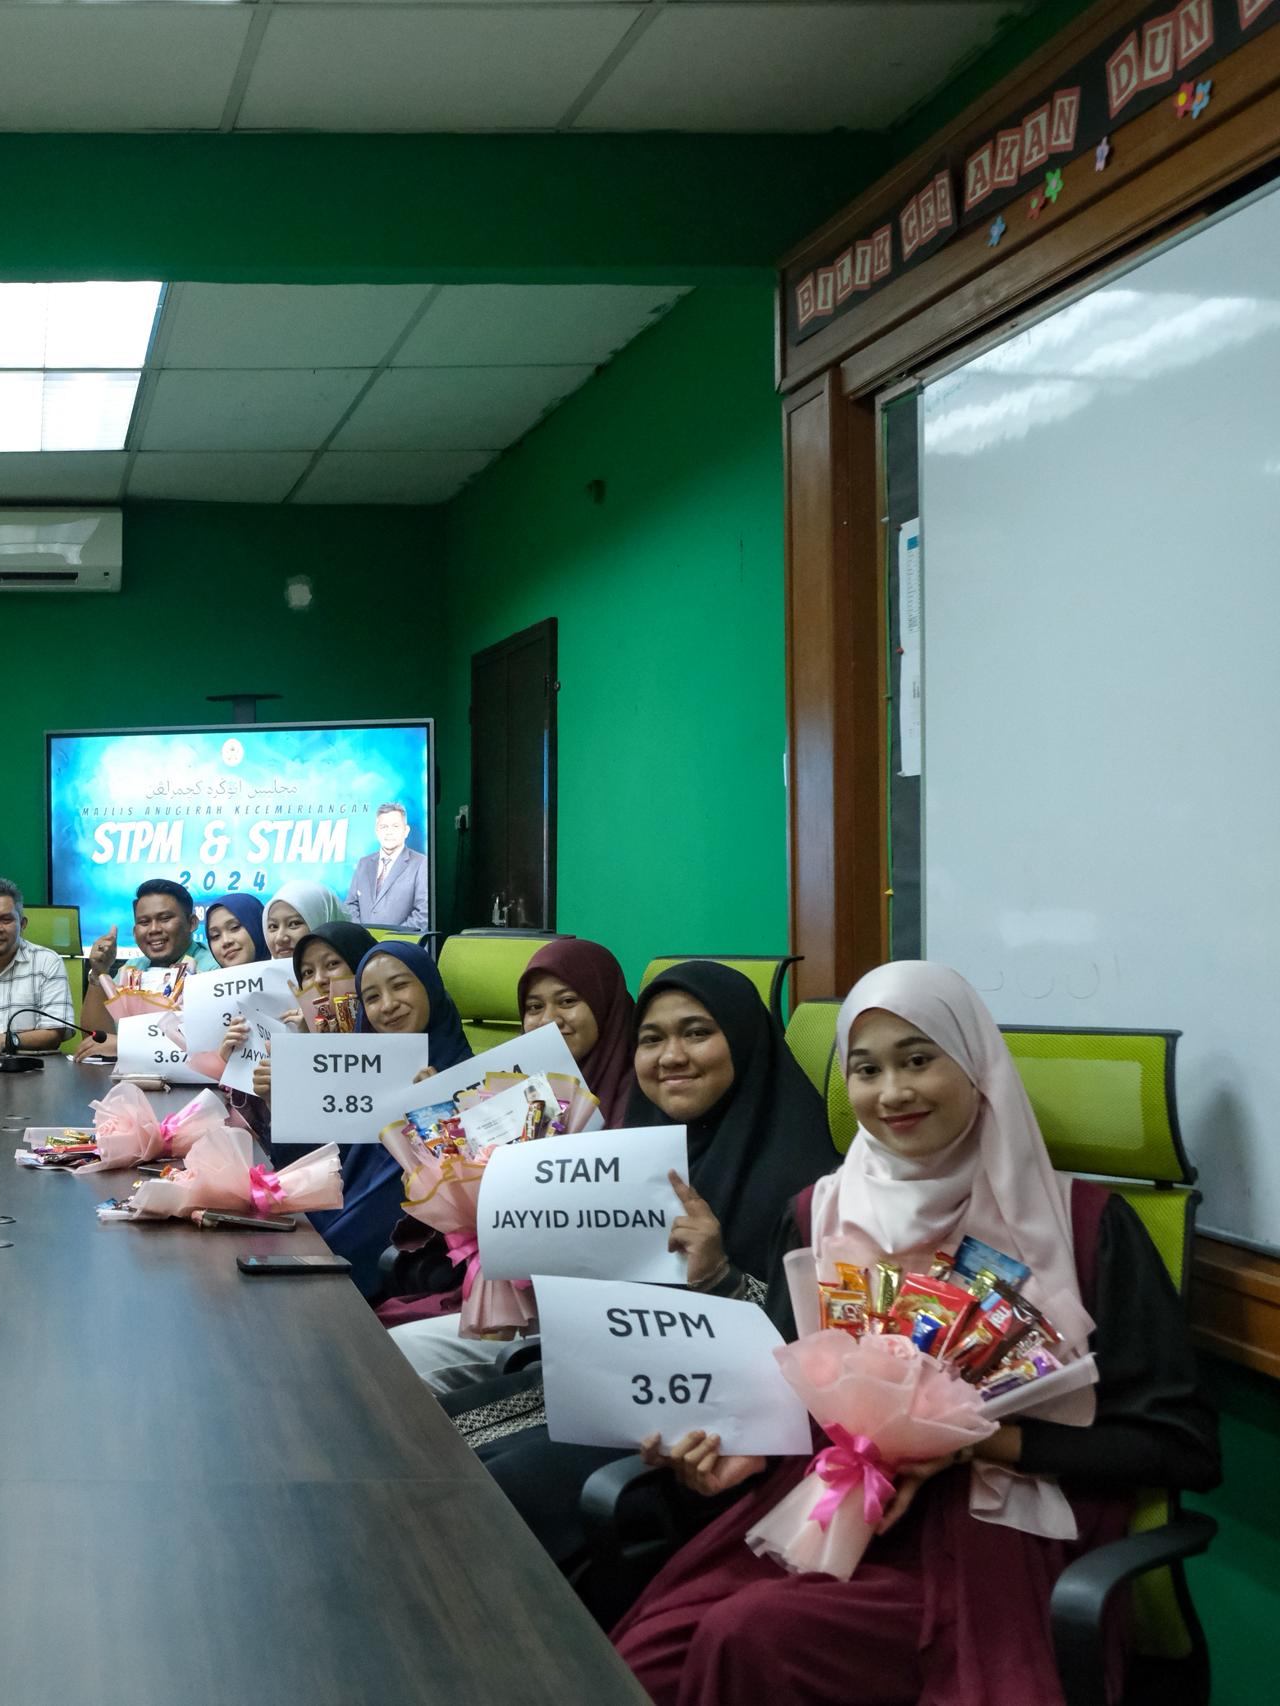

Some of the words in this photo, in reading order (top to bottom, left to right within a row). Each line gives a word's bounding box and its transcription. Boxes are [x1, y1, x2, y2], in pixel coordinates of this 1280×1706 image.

[797, 230, 891, 324] BILIK
[1111, 1, 1209, 106] DUN
[81, 806, 135, 816] MAJLIS
[144, 805, 223, 815] ANUGERAH
[234, 803, 371, 815] KECEMERLANGAN
[91, 819, 184, 864] STPM
[199, 818, 231, 863] &
[246, 817, 349, 864] STAM
[179, 870, 265, 891] 2024
[213, 976, 264, 998] STPM
[312, 1053, 382, 1074] STPM
[322, 1094, 374, 1114] 3.83
[534, 1156, 620, 1184] STAM
[492, 1209, 570, 1229] JAYYID
[576, 1209, 666, 1229] JIDDAN
[607, 1307, 716, 1339] STPM
[631, 1373, 713, 1405] 3.67
